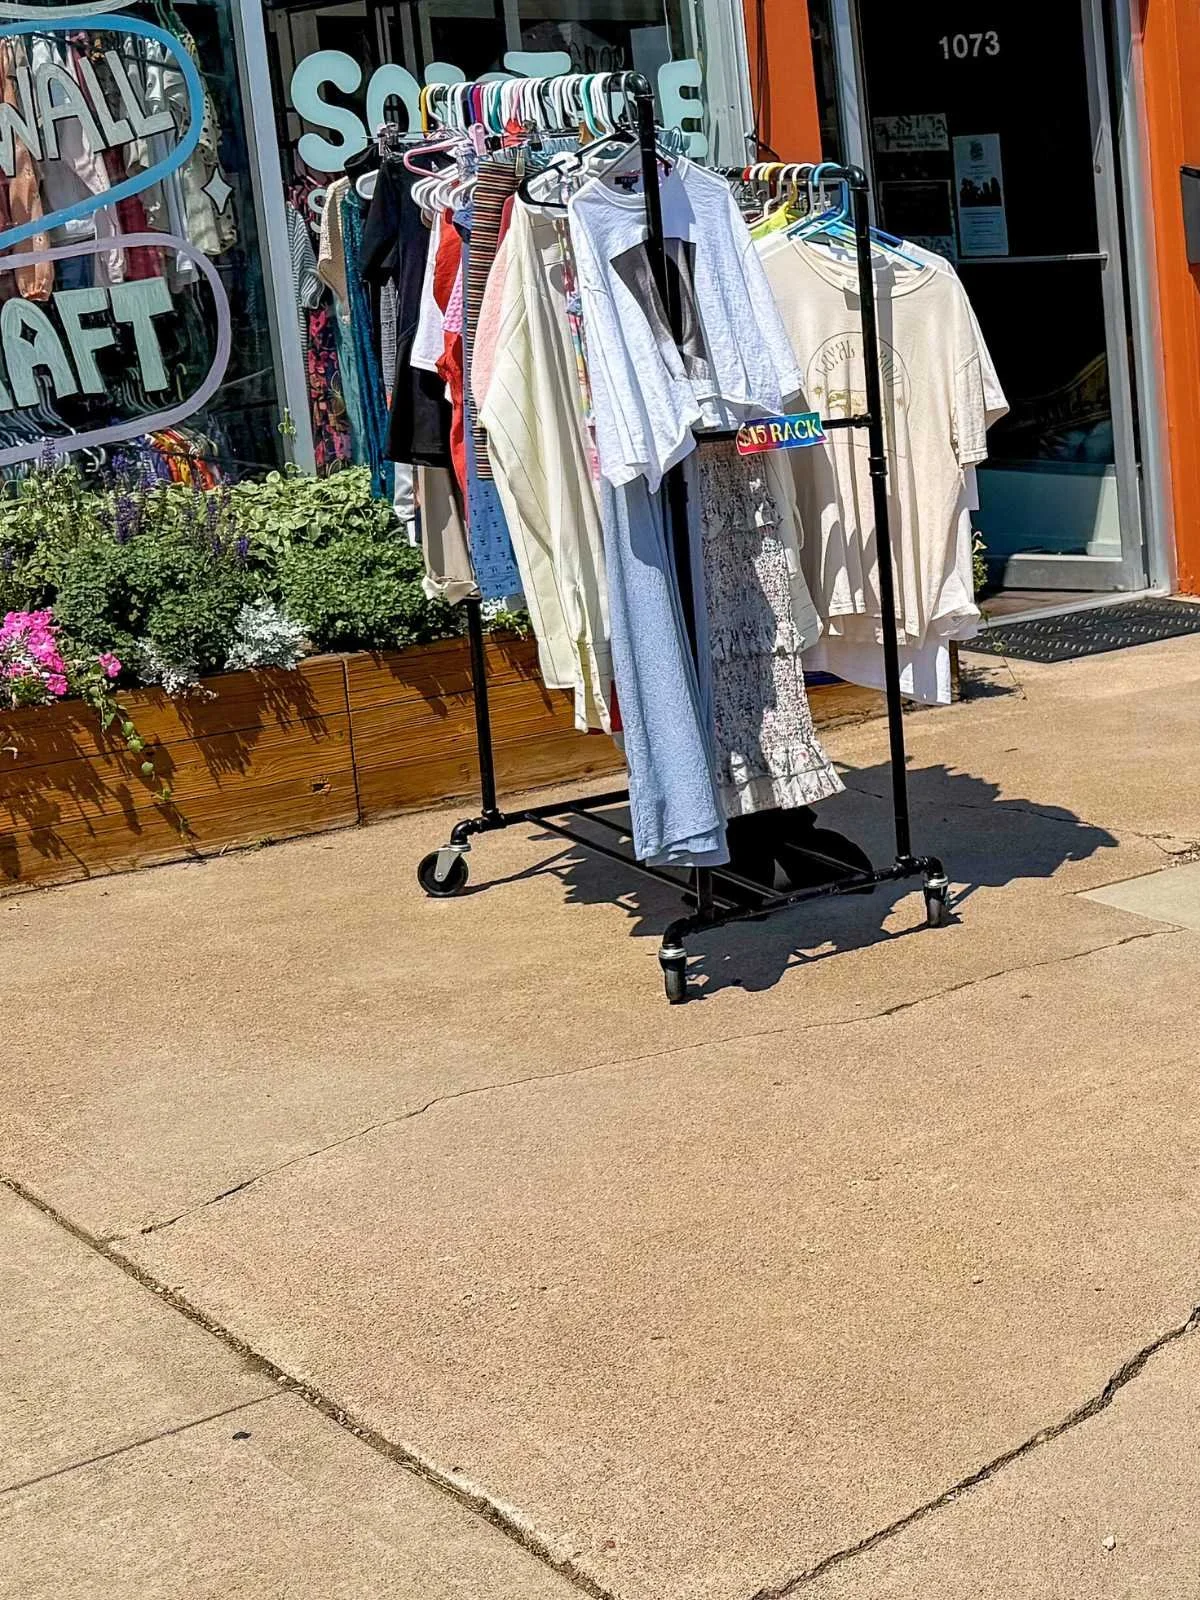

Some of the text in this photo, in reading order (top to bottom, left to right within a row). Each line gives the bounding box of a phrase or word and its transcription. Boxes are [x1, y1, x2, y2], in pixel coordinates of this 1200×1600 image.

[939, 30, 1000, 59] 1073
[0, 277, 174, 410] AFT
[738, 419, 823, 447] $15 RACK
